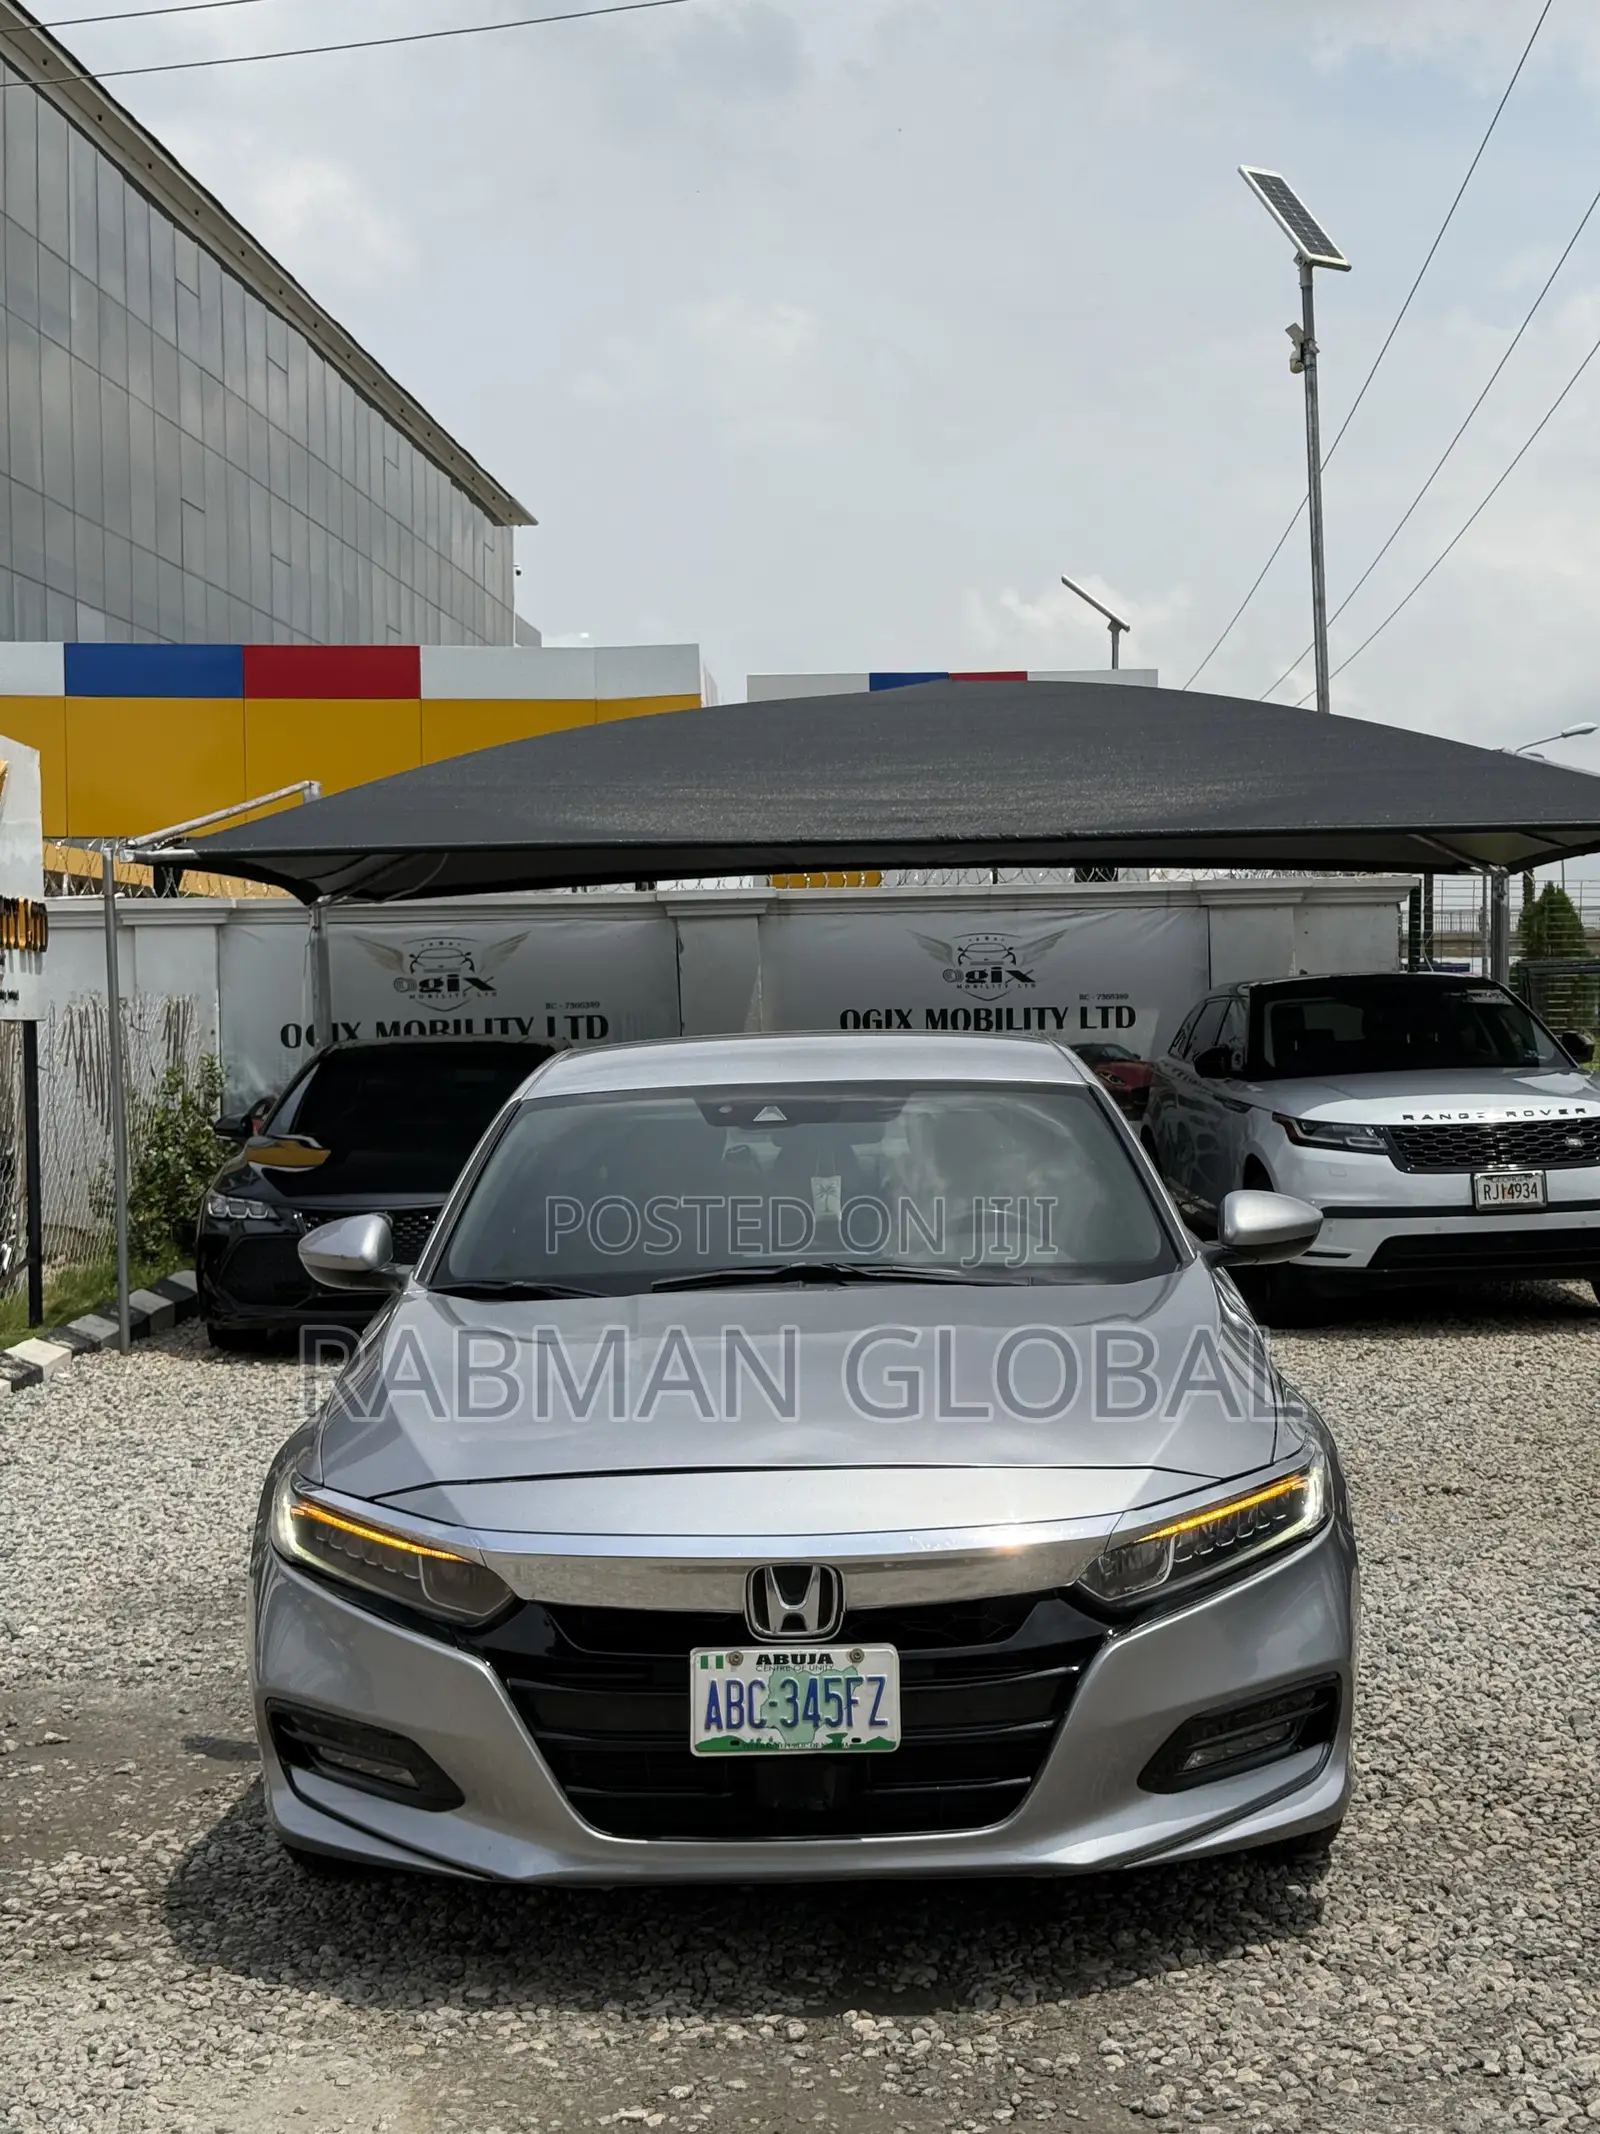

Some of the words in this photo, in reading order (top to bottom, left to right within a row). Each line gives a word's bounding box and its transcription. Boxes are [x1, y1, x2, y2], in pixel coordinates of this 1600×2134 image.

[839, 1008, 913, 1029] OGIX
[925, 1007, 1069, 1032] MOBILITY
[1080, 1005, 1136, 1029] LTD
[1402, 1111, 1486, 1121] RANGE
[1505, 1107, 1587, 1118] ROVER
[756, 1653, 834, 1665] ABUJA
[755, 1664, 791, 1673] CENTRE
[794, 1664, 806, 1672] OF
[809, 1663, 835, 1672] UNITY
